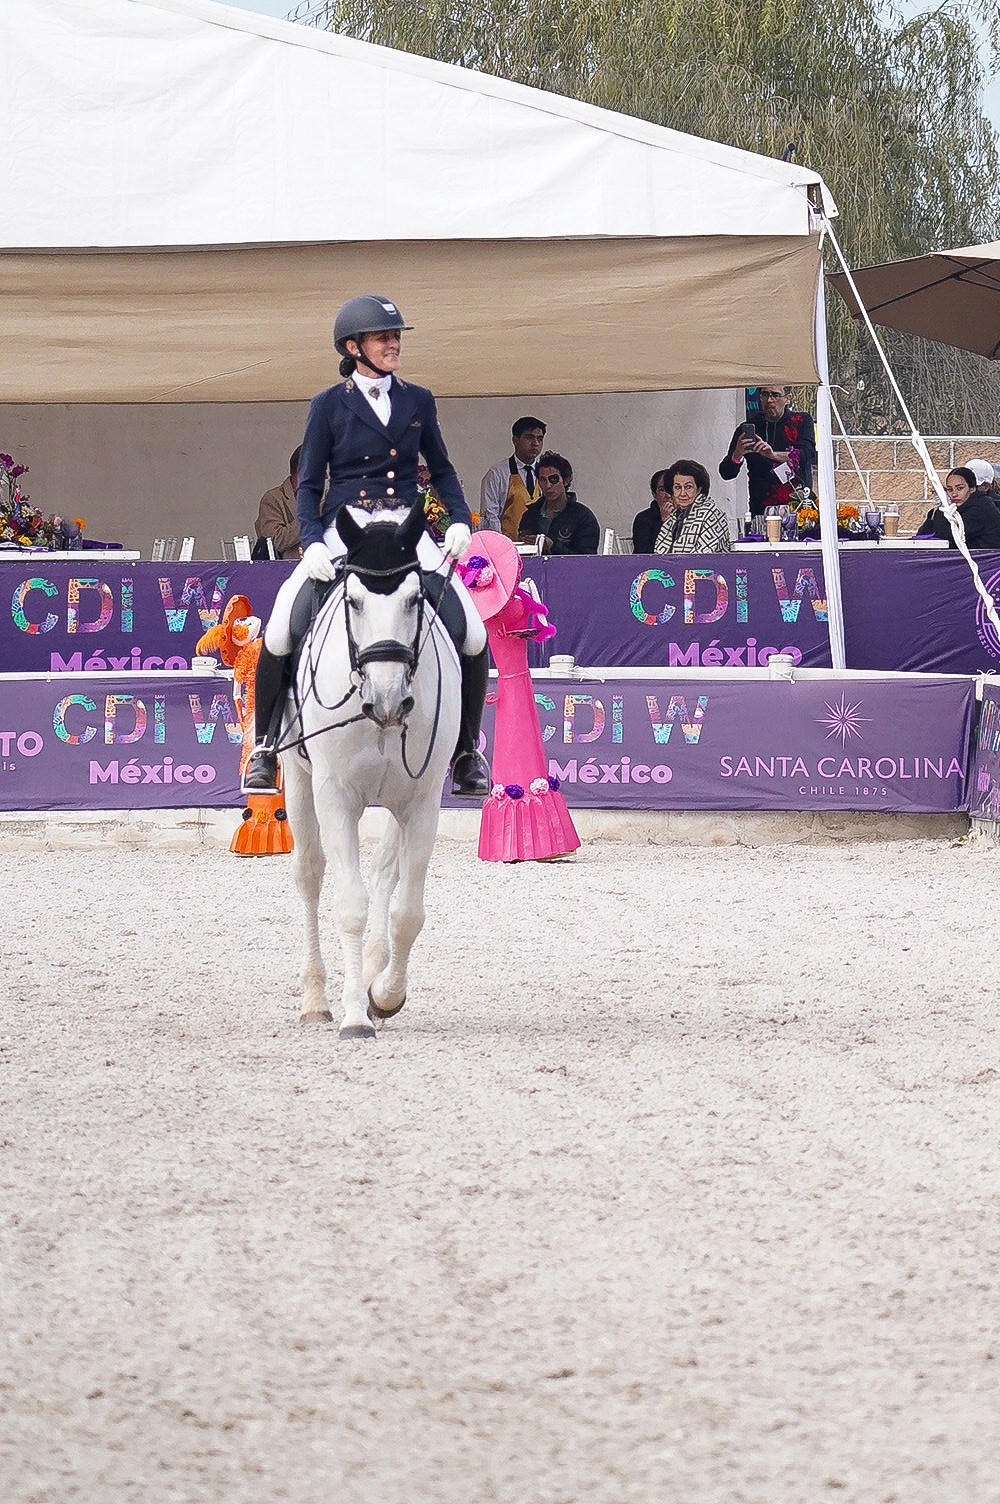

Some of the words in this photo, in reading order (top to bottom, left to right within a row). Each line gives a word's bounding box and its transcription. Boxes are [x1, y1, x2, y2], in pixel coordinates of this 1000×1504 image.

[11, 577, 134, 635] CDI
[158, 576, 229, 633] W
[630, 569, 748, 625] CDI
[53, 694, 166, 745] CDI
[188, 694, 248, 744] W
[646, 694, 710, 744] W
[89, 756, 216, 784] México
[548, 756, 673, 784] México
[720, 756, 810, 778] SANTA
[817, 757, 965, 779] CAROLINA
[799, 786, 845, 795] CHILE
[855, 786, 888, 796] 1875
